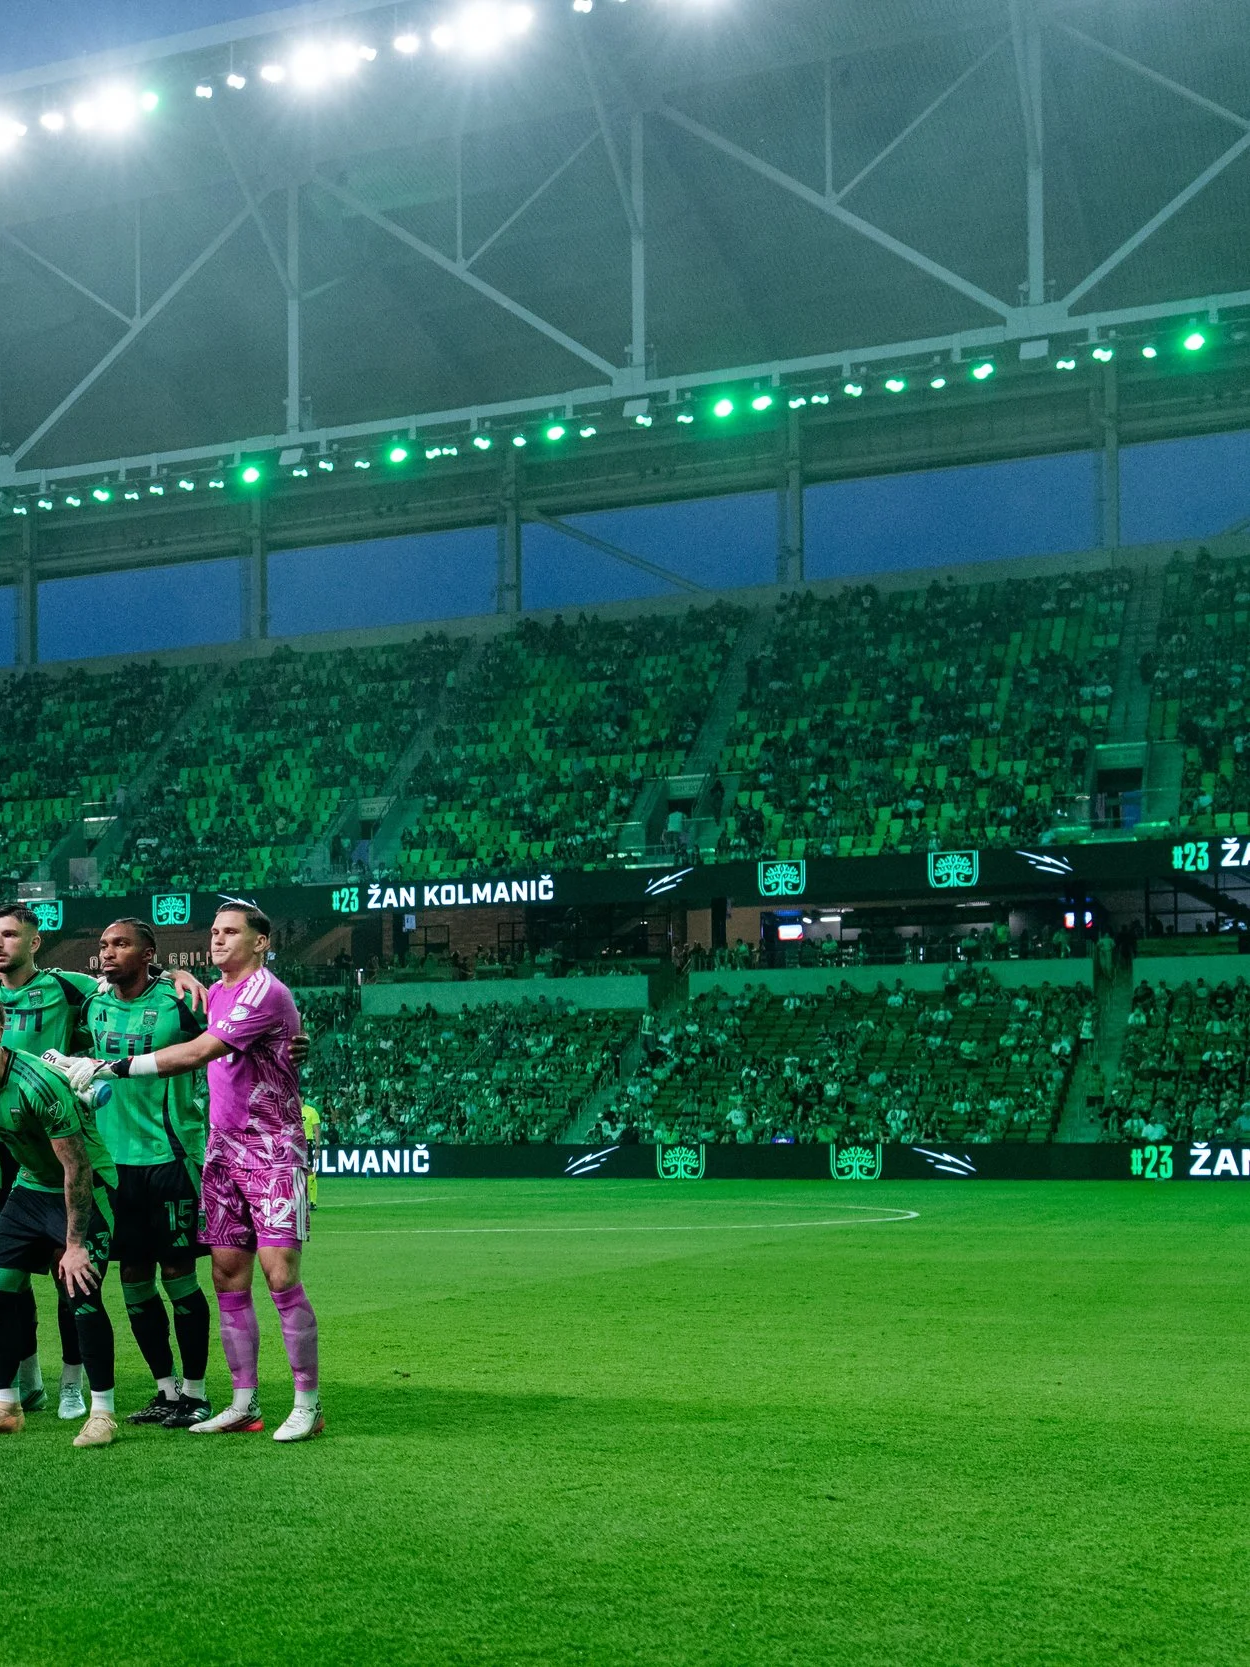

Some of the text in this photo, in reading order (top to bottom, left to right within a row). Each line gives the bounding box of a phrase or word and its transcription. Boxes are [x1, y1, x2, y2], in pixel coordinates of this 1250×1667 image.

[1172, 842, 1209, 871] #23
[332, 874, 554, 912] #23 ŽAN KOLMANIČ
[94, 1028, 152, 1056] YETI
[1131, 1144, 1173, 1179] #23
[164, 1199, 193, 1231] 15
[260, 1197, 293, 1229] 12
